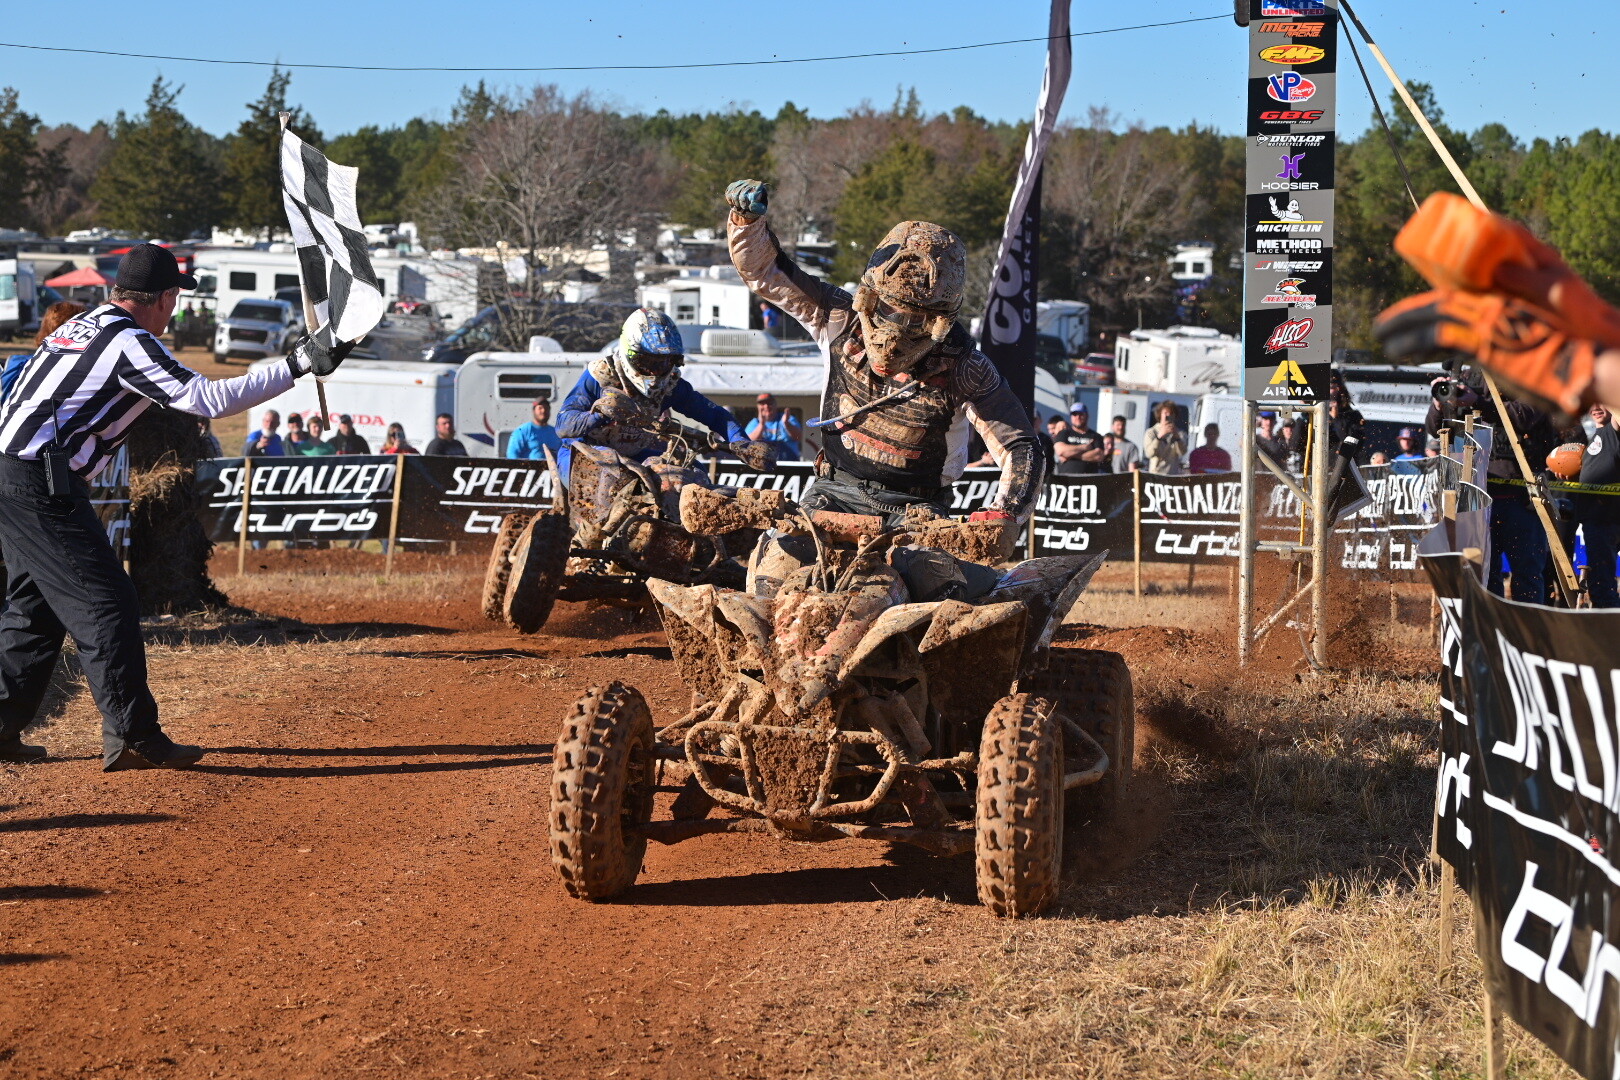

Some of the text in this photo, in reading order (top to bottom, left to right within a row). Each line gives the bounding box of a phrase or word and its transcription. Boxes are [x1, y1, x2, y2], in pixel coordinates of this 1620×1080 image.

[1259, 22, 1325, 33] MOOSE
[1260, 47, 1324, 59] FMF
[1268, 72, 1301, 100] VP
[1260, 111, 1325, 120] GBC
[1270, 135, 1326, 143] DUNLOP
[1261, 182, 1319, 190] HOOSIER
[1256, 224, 1323, 233] MICHELIN
[1256, 239, 1322, 249] METHOD
[1022, 211, 1033, 324] GASKET
[1272, 261, 1324, 270] WISECO
[1262, 386, 1315, 396] ARMA
